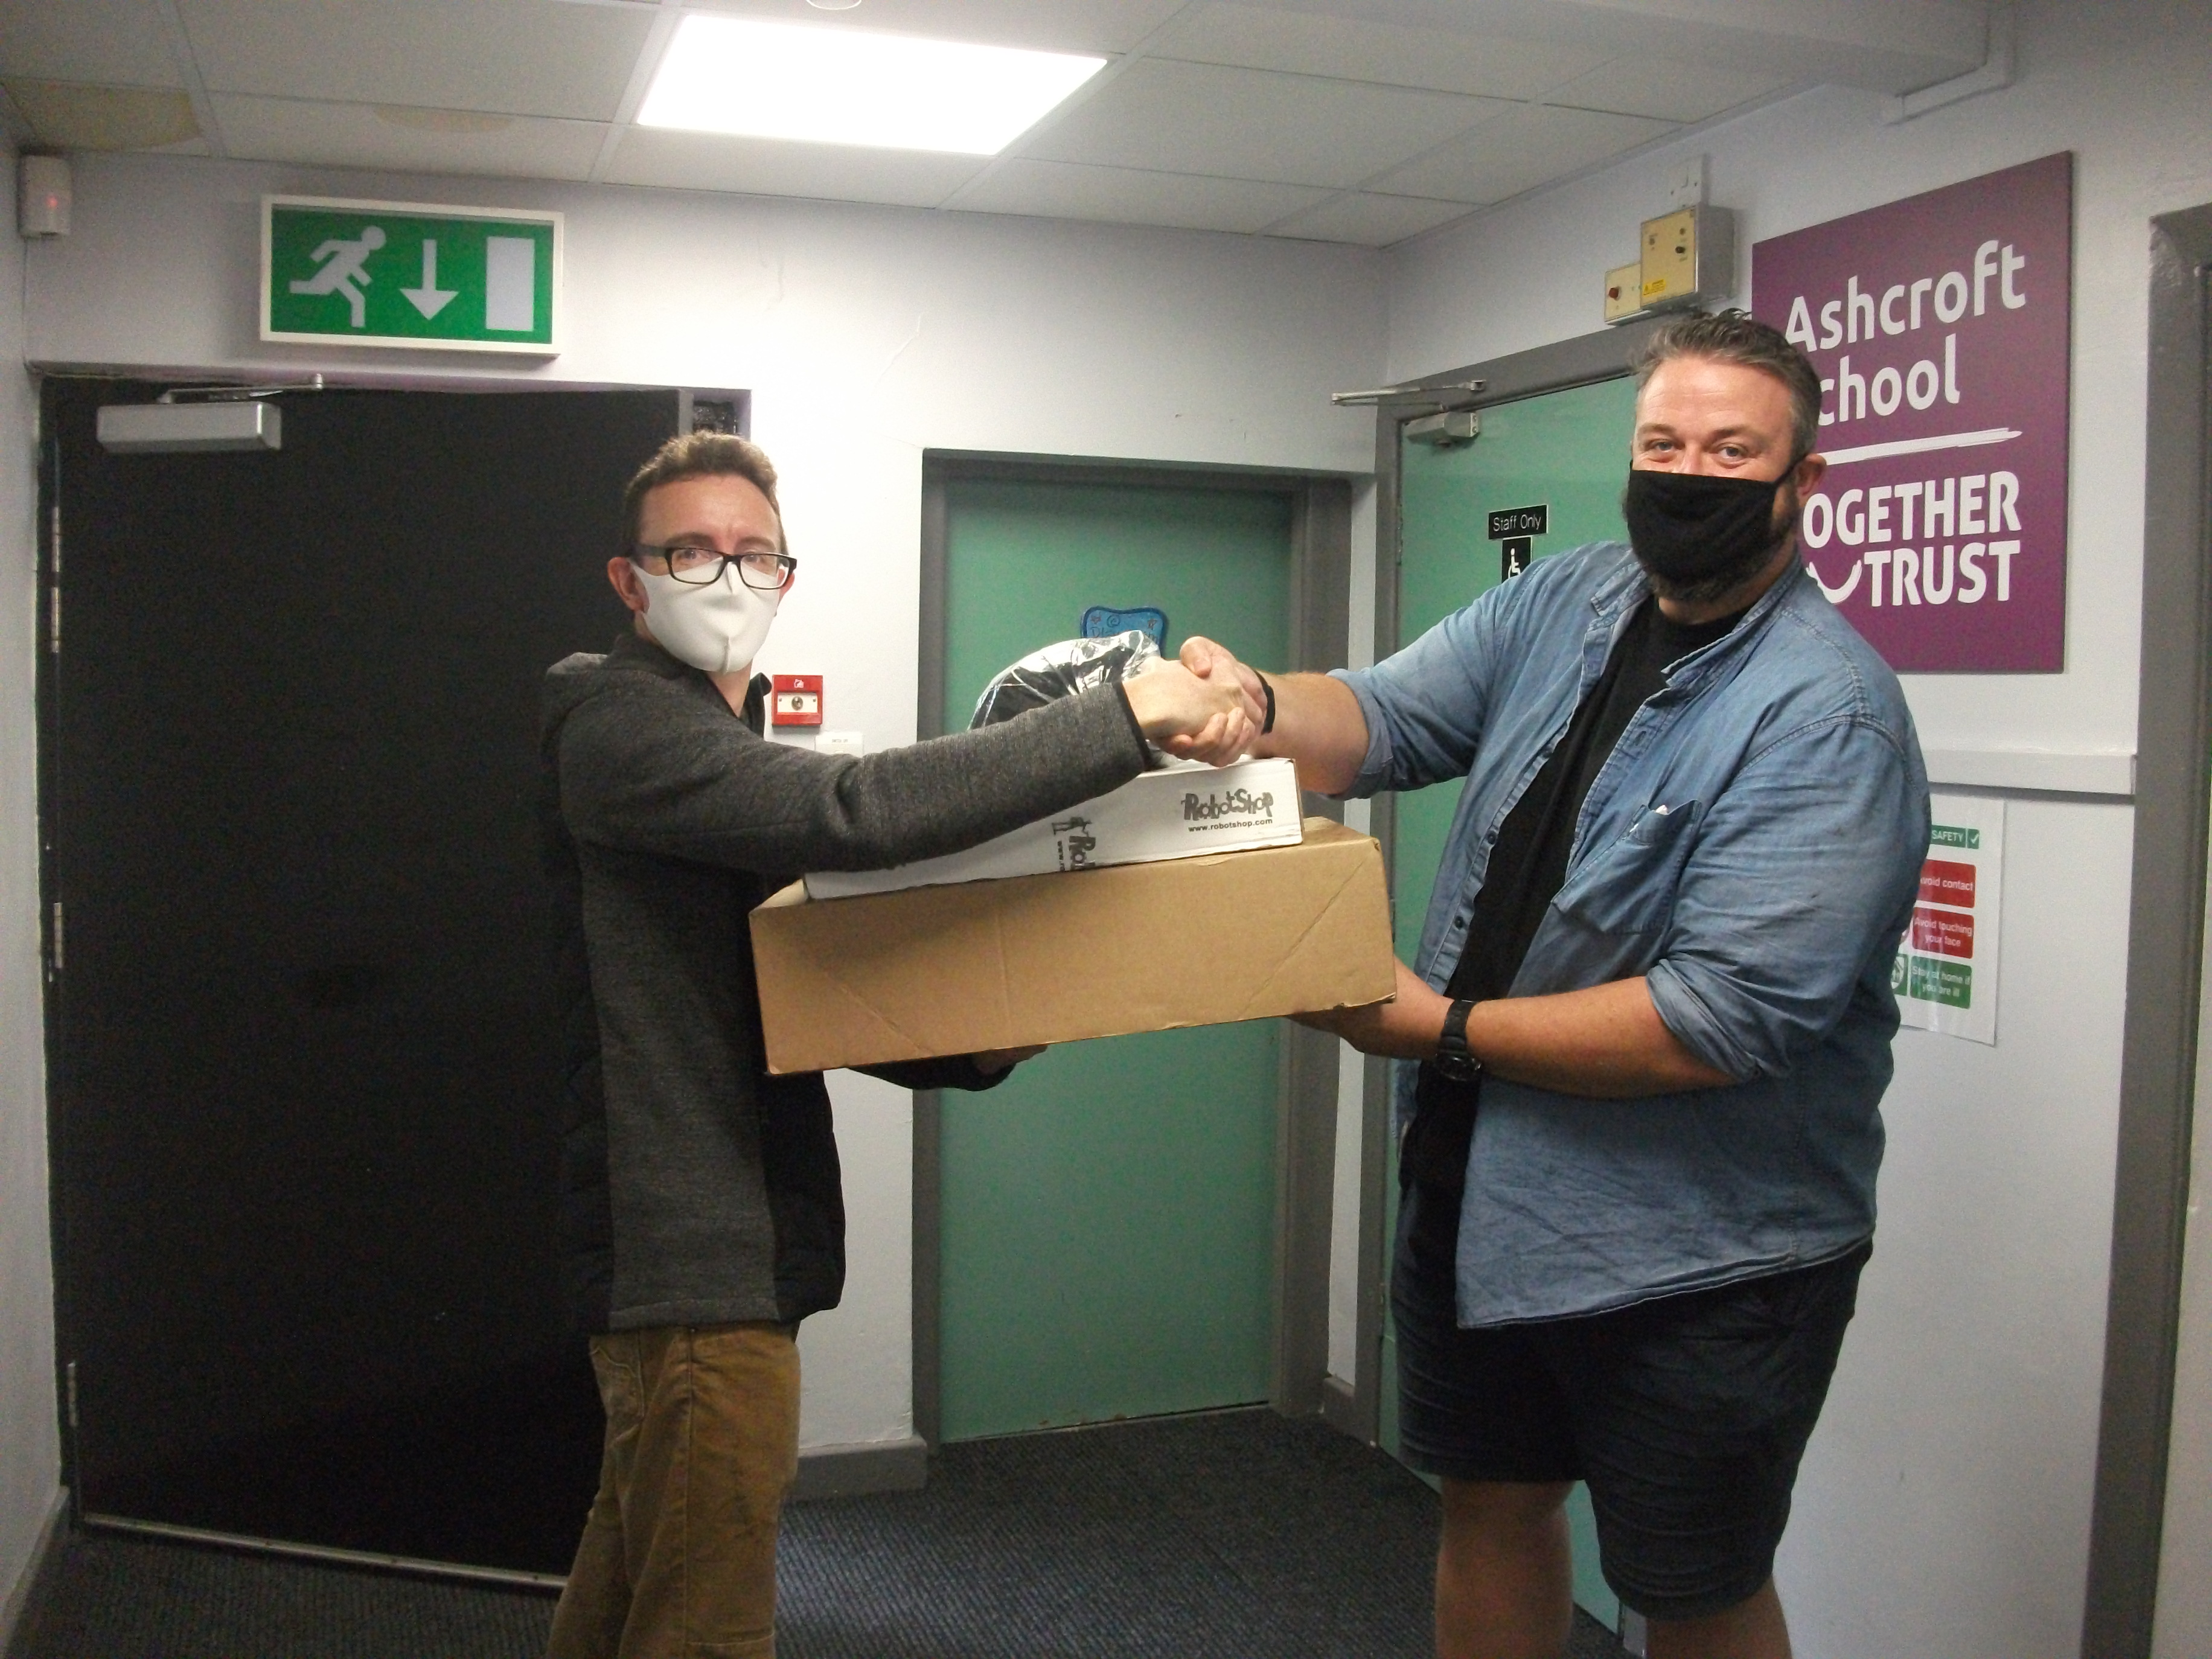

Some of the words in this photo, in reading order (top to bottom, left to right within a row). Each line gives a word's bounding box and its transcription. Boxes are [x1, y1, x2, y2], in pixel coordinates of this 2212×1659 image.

[1785, 240, 2026, 352] Ashcroft
[1817, 334, 1960, 426] chool
[1803, 470, 2022, 549] OGETHER
[1493, 515, 1517, 532] Staff
[1520, 514, 1541, 530] Only
[1864, 540, 2021, 607] TRUST
[1188, 819, 1273, 832] www.robotshop.com
[1932, 830, 1964, 842] SAFETY
[1942, 880, 1973, 890] contact
[1939, 921, 1972, 937] touching
[1945, 936, 1961, 947] face
